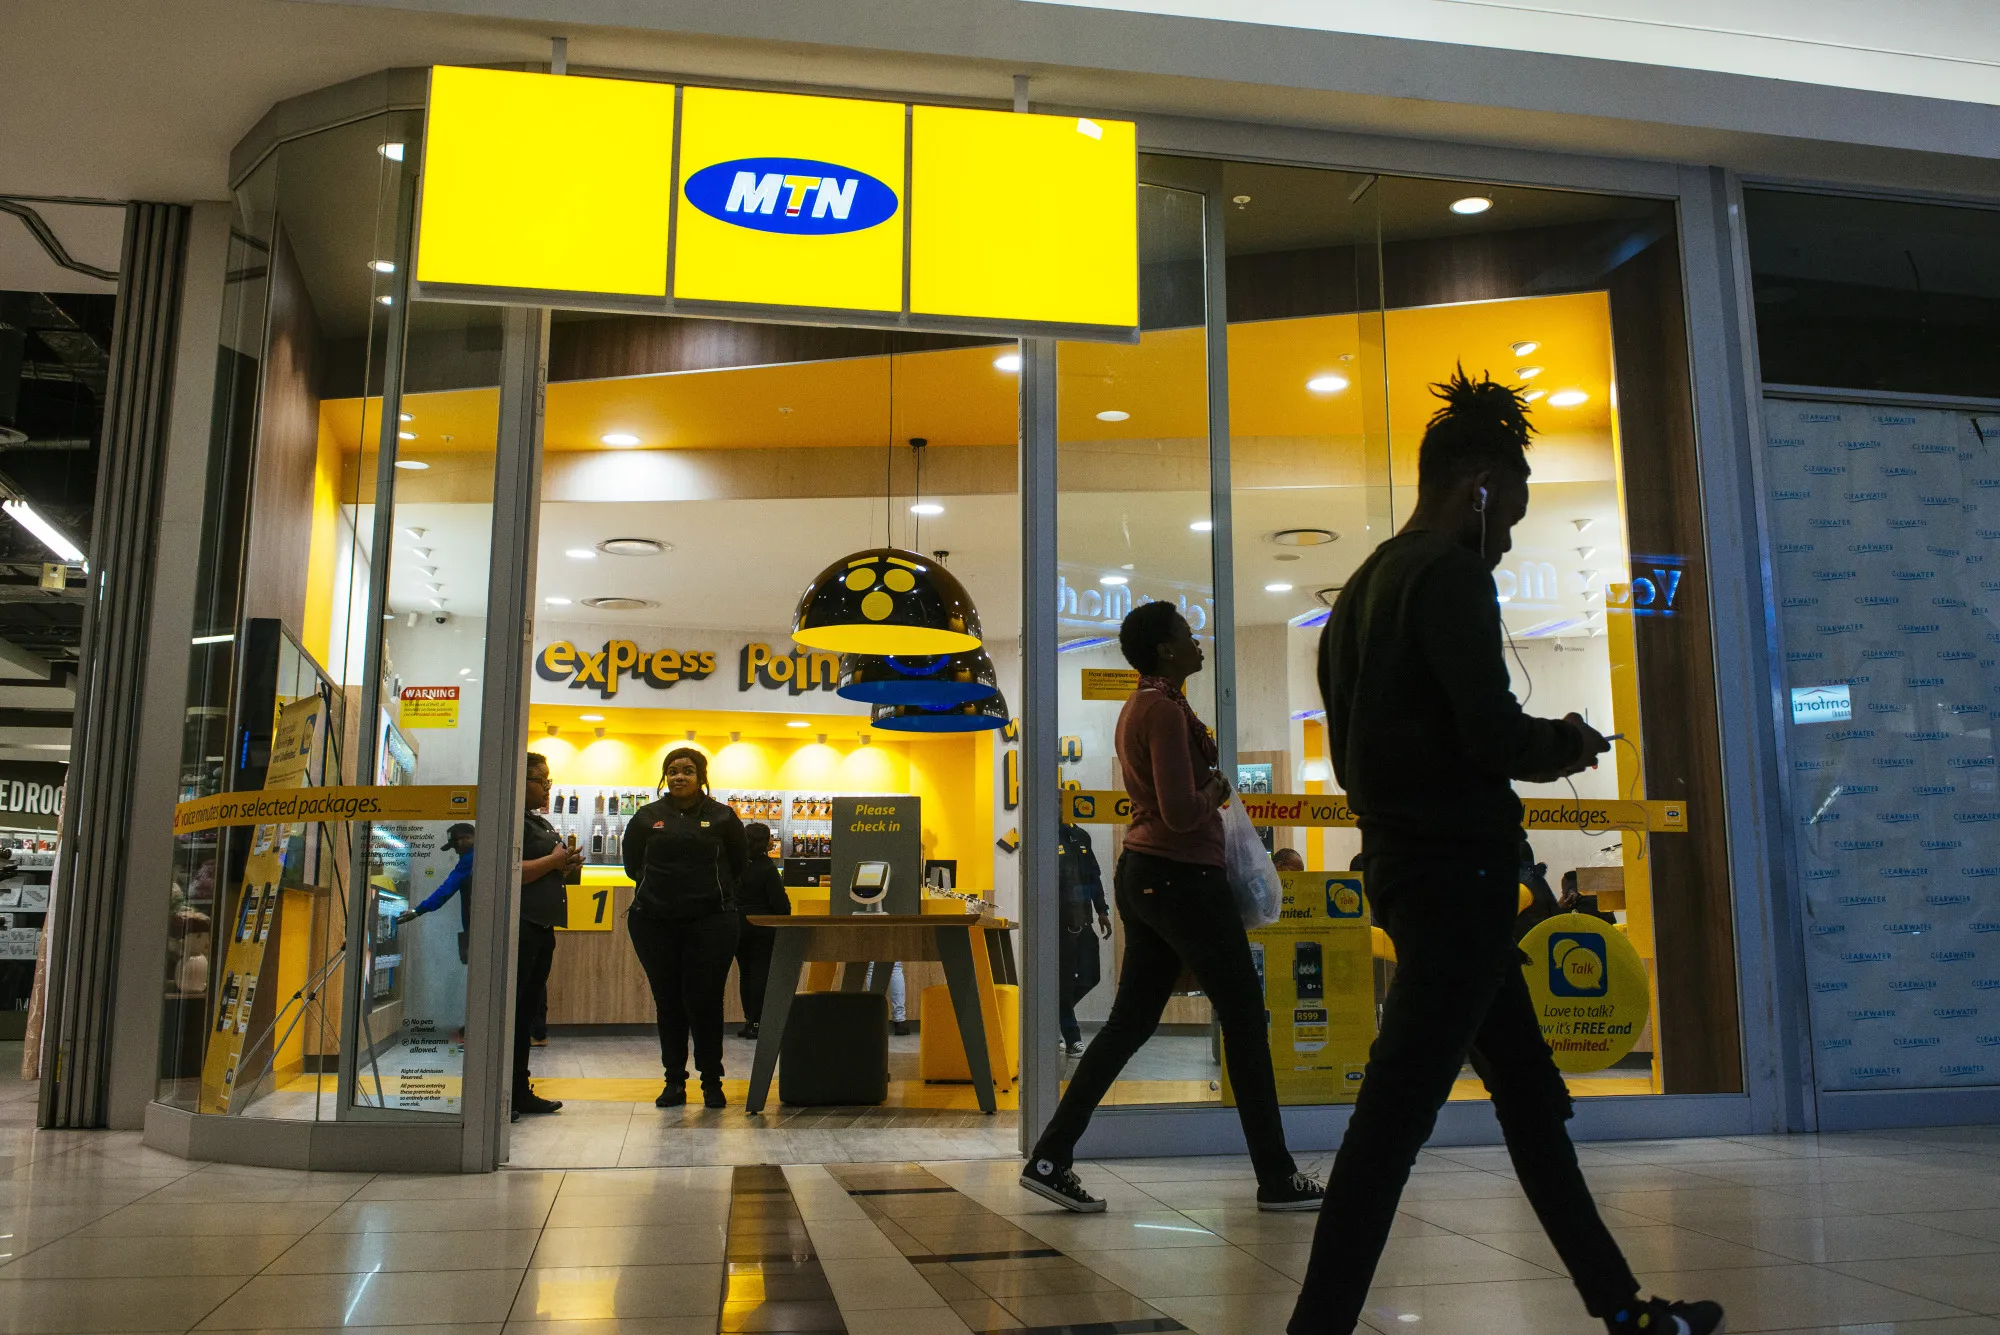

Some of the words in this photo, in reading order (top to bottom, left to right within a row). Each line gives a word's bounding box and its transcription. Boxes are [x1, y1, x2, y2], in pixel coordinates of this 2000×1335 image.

[726, 171, 859, 220] MTN
[538, 639, 716, 697] express
[404, 689, 456, 699] WARNING
[220, 805, 238, 818] on
[240, 795, 297, 817] selected
[298, 793, 381, 819] packages.
[855, 804, 896, 816] Please
[1311, 802, 1355, 820] voice
[1528, 804, 1610, 828] packages.
[850, 820, 886, 832] check
[888, 820, 900, 832] in
[592, 890, 608, 924] 1
[1571, 962, 1594, 975] Talk
[1296, 1011, 1319, 1021] R599
[1544, 1004, 1571, 1018] Love
[1572, 1005, 1585, 1018] to
[1587, 1004, 1615, 1018] talk?
[1555, 1022, 1570, 1035] it's
[1573, 1022, 1605, 1035] FREE
[1607, 1022, 1632, 1035] and
[420, 1037, 449, 1045] firearms
